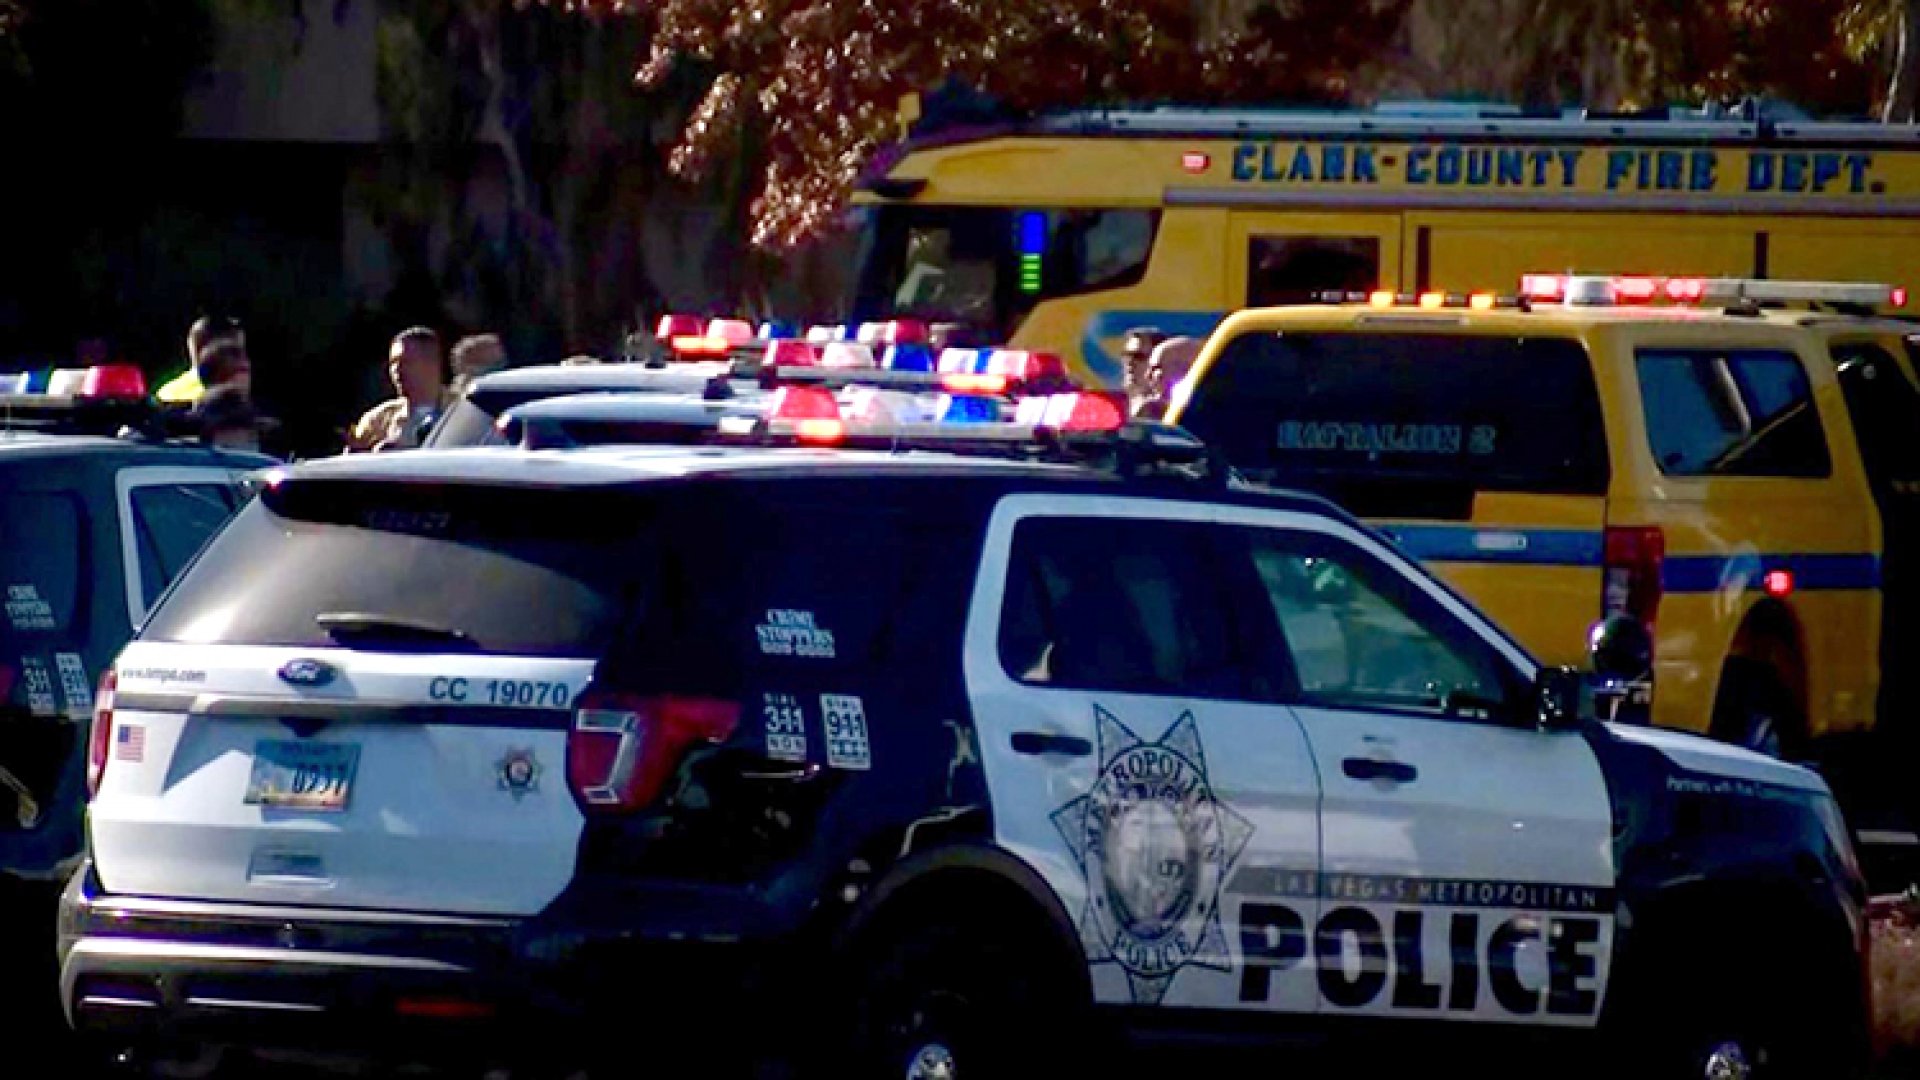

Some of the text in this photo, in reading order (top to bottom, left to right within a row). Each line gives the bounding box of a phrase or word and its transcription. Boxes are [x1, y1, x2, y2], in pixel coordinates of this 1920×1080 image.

[1605, 150, 1718, 191] FIRE
[1747, 152, 1886, 193] DEPT.
[430, 676, 569, 705] CC 19070
[1274, 872, 1597, 907] LAS VEGAS METROPOLITAN
[1238, 901, 1602, 1016] POLICE
